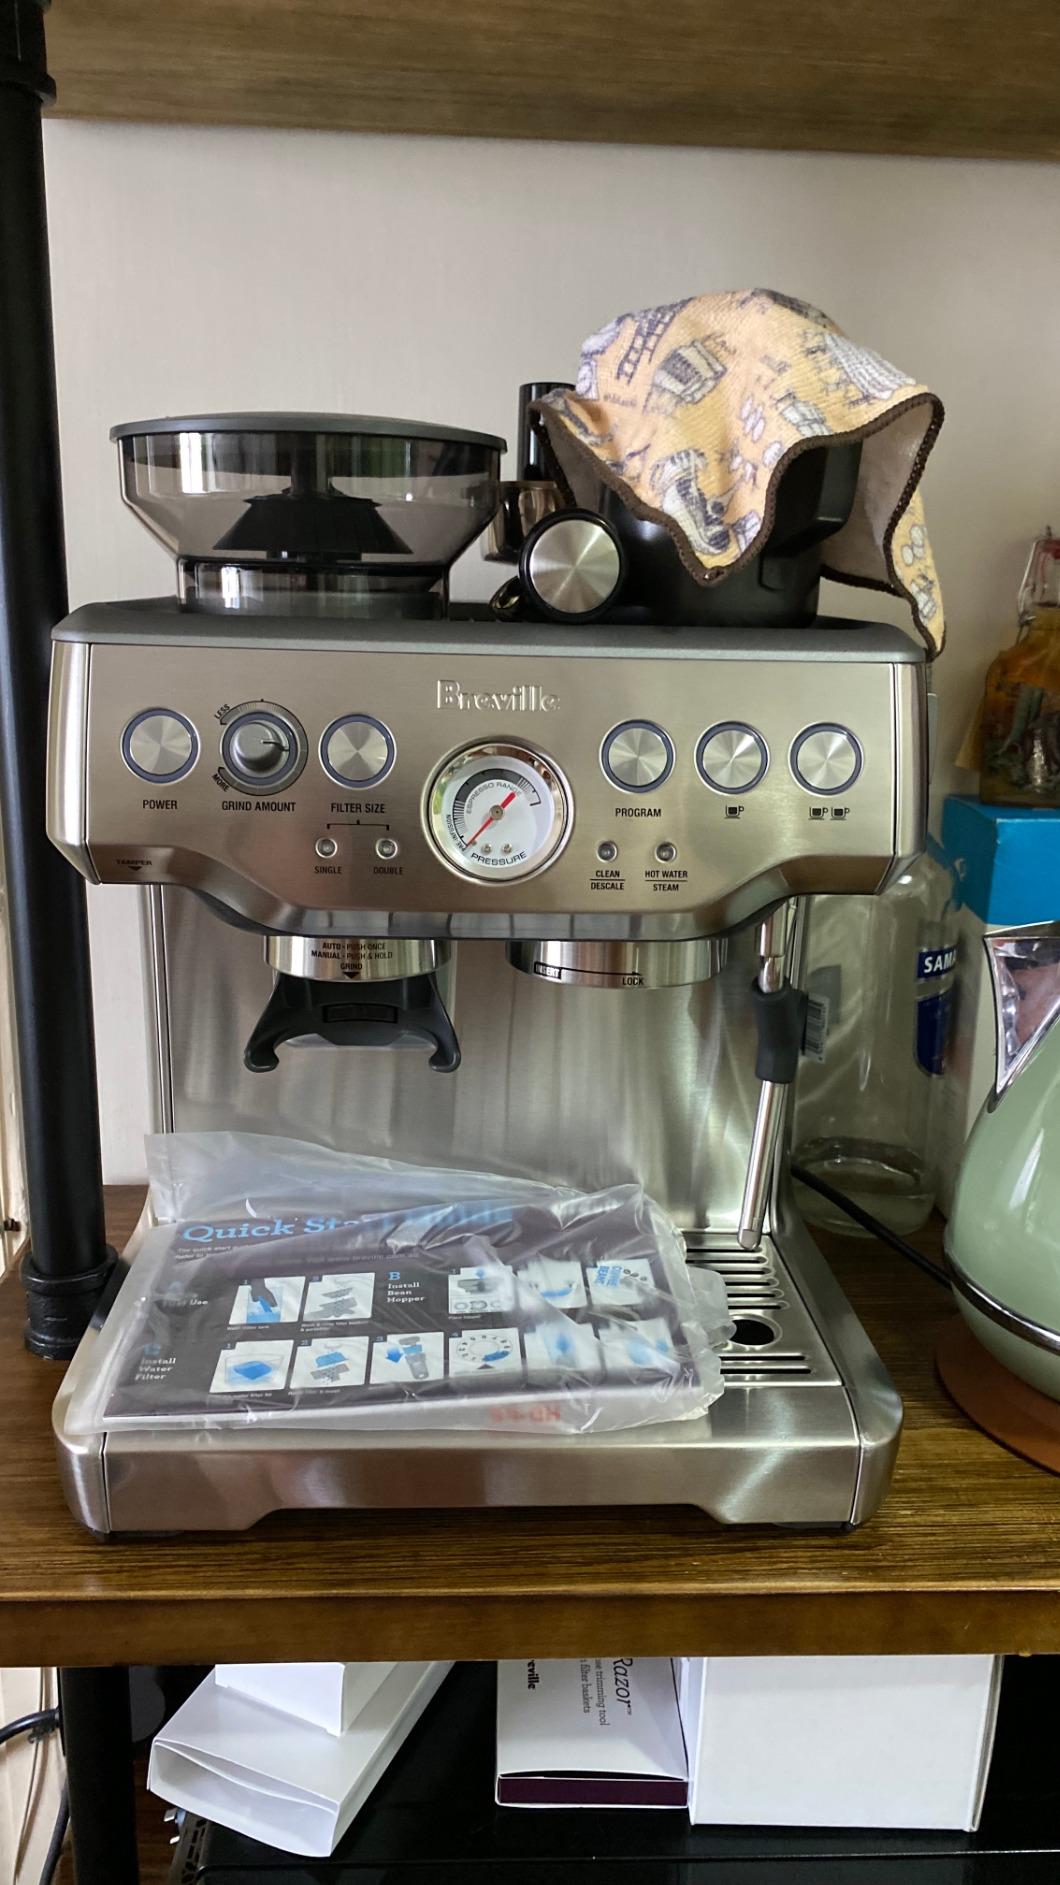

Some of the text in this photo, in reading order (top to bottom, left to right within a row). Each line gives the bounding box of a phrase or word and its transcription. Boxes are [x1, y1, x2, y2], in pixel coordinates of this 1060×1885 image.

[437, 679, 560, 711] Breville
[214, 703, 231, 721] LESS
[211, 773, 230, 792] MORE
[466, 782, 495, 814] ESPRESSO
[142, 799, 178, 810] POWER
[221, 801, 296, 812] GRIND AMOUNT
[330, 803, 386, 814] FILTER SIZE
[615, 807, 662, 817] PROGRAM
[471, 851, 527, 866] PRESSURE
[314, 865, 342, 875] SINGLE
[373, 866, 404, 876] DOUBLE
[595, 870, 620, 878] CLEAN
[645, 870, 688, 878] HOT WATER
[590, 882, 625, 891] DESCALE
[653, 883, 679, 892] STEAM
[322, 942, 341, 950] AUTO
[311, 950, 341, 959] MANUAL
[374, 951, 393, 959] HOLD
[340, 962, 362, 970] GRIND
[535, 963, 560, 978] INSERT
[622, 977, 645, 986] LOCK
[183, 1216, 294, 1243] Quick
[388, 1271, 401, 1280] B
[141, 1357, 176, 1365] Install
[596, 1671, 607, 1708] trimming
[599, 1710, 610, 1727] tool
